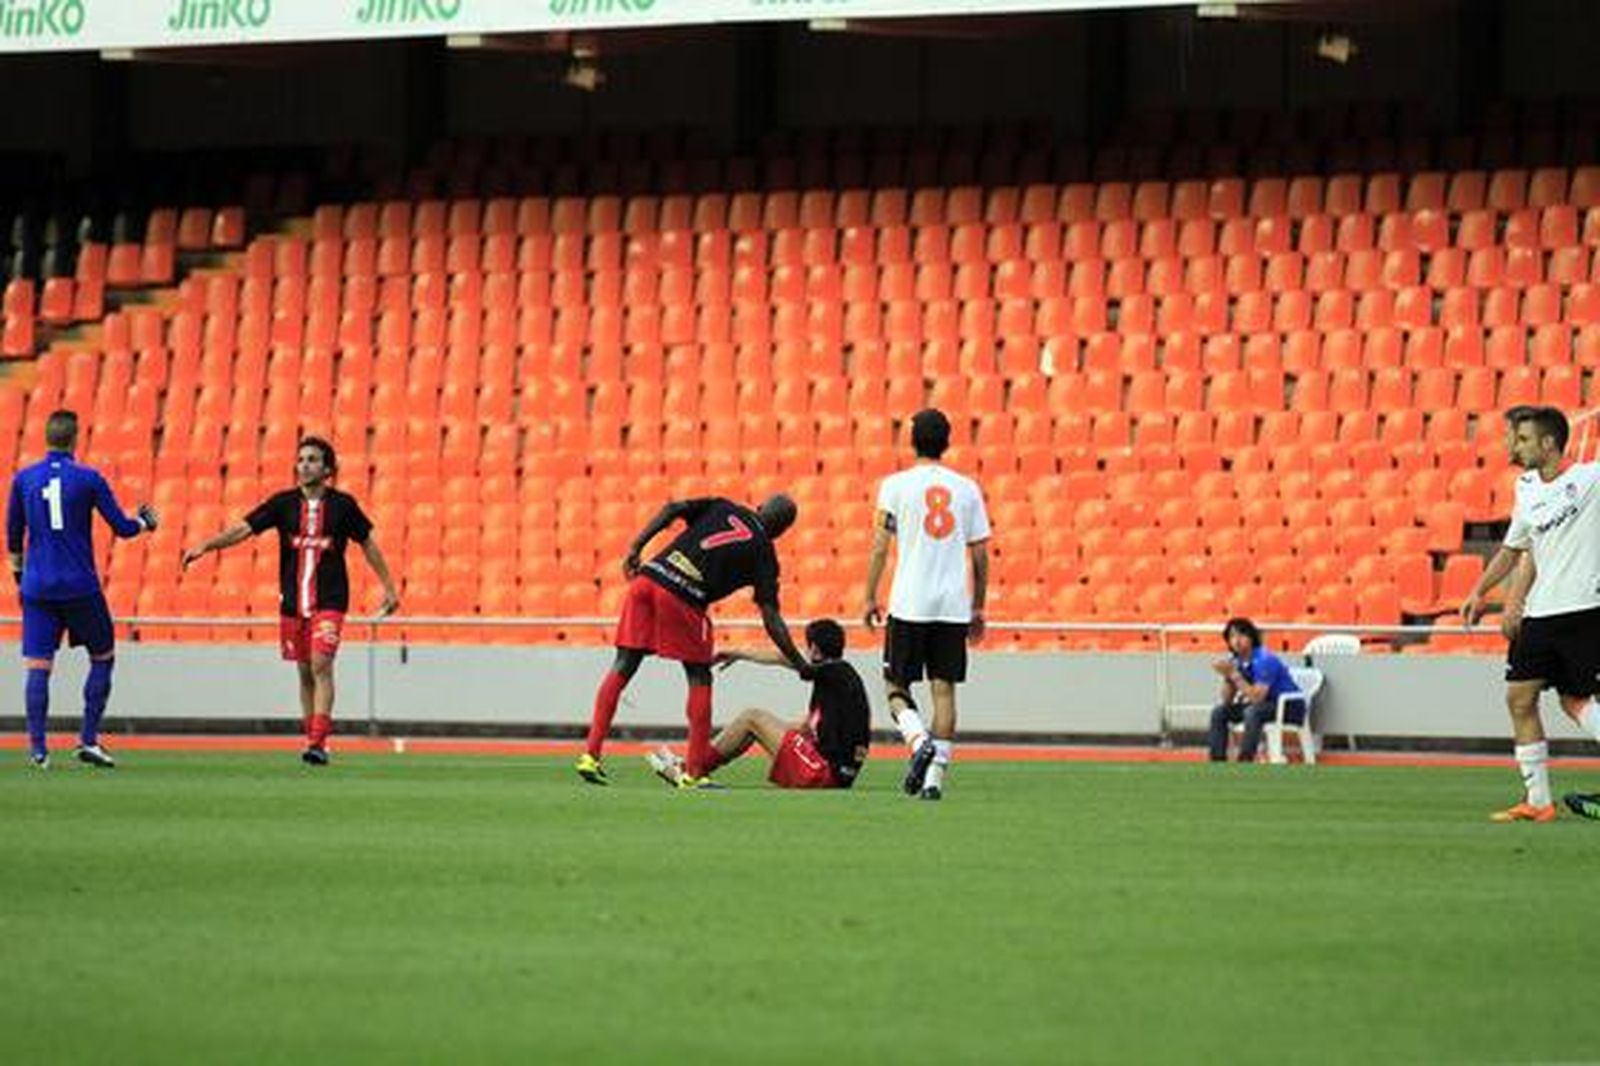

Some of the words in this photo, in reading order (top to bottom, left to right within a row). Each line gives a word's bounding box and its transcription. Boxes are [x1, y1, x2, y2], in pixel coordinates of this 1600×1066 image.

[0, 0, 85, 36] inKO
[42, 477, 63, 530] 1
[924, 486, 955, 540] 8
[700, 515, 752, 549] 7
